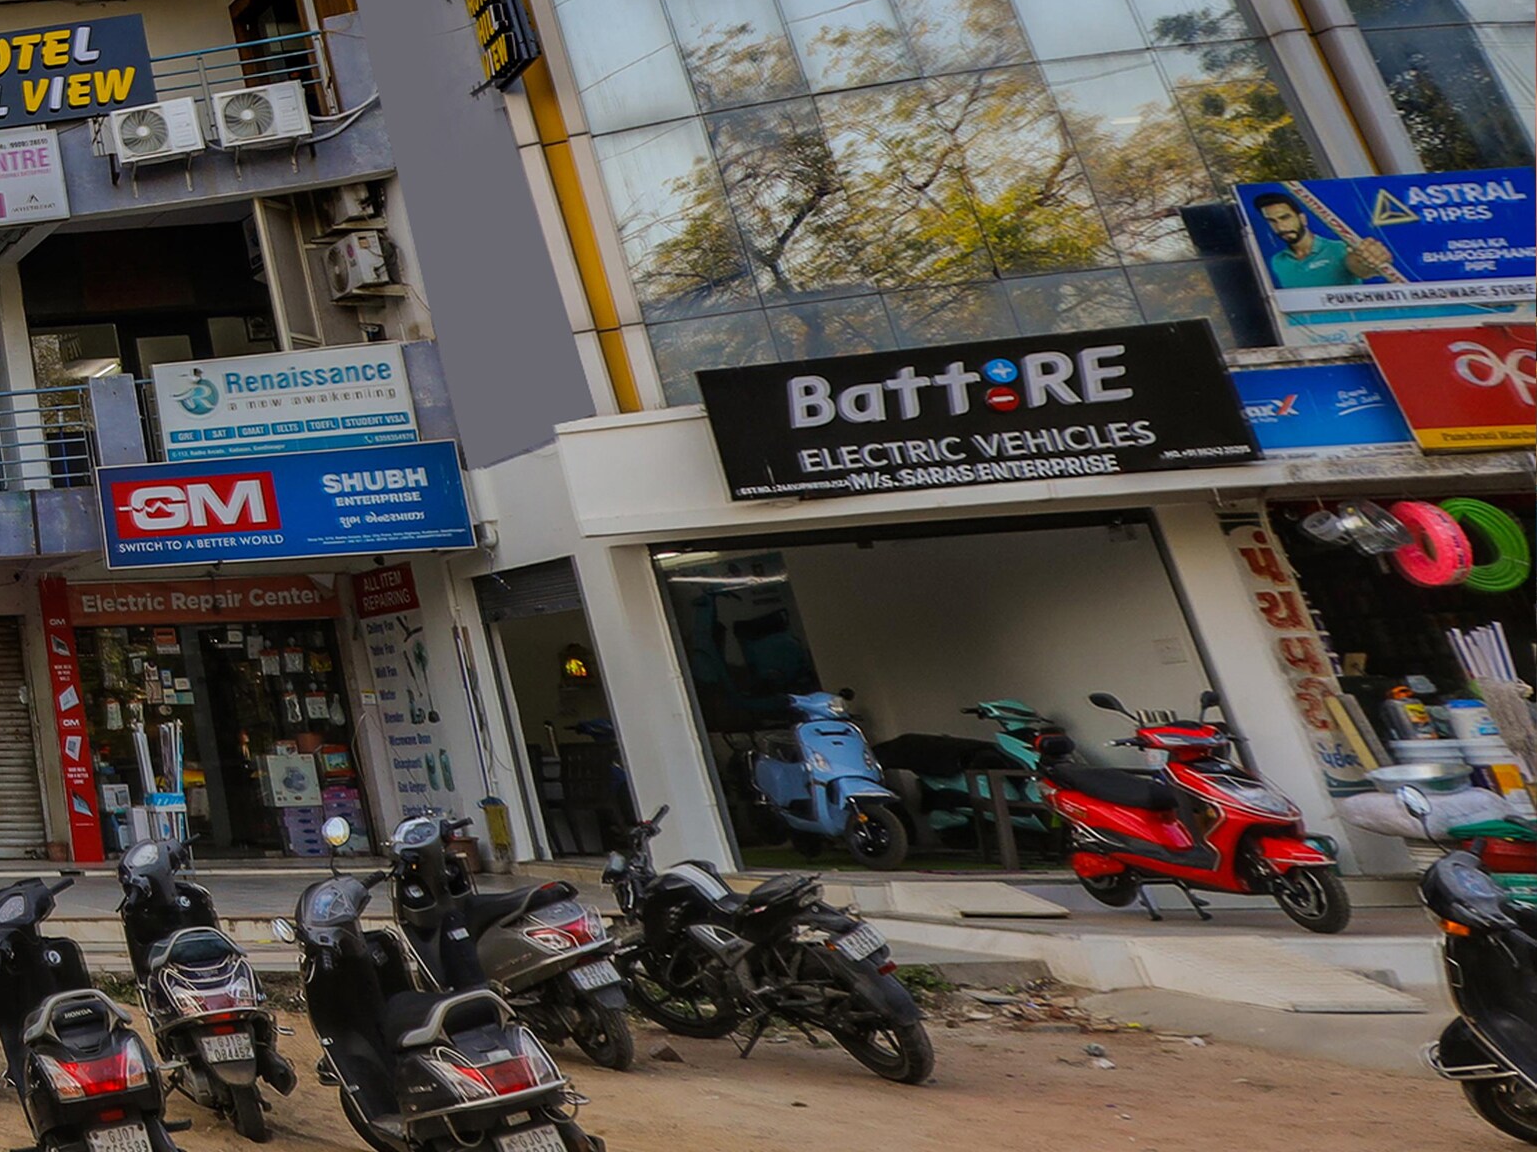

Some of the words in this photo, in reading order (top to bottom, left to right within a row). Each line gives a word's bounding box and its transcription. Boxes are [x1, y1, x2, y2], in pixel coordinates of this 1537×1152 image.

[22, 66, 136, 113] VIEW
[1408, 179, 1528, 205] ASTRAL
[1422, 205, 1493, 223] PIPES
[1326, 290, 1407, 305] PUNCHWATI
[1411, 285, 1488, 300] HARDWARE
[1490, 282, 1536, 296] STORE
[225, 360, 392, 394] Renaissance
[227, 401, 238, 412] a
[246, 397, 283, 411] new
[291, 386, 397, 408] awakening
[212, 428, 227, 439] SAT
[276, 422, 299, 433] IELTS
[310, 419, 336, 430] TOEFL
[344, 415, 385, 427] STUDENT
[386, 413, 406, 424] VISA
[798, 436, 963, 473] ELECTRIC
[971, 420, 1157, 458] VEHICLES
[322, 467, 429, 494] SHUBH
[901, 462, 975, 486] SARAS
[976, 452, 1120, 482] ENTERPRISE
[118, 480, 267, 531] GM
[335, 491, 422, 507] ENTERPRISE
[119, 540, 163, 553] SWITCH
[166, 541, 182, 551] TO
[186, 539, 195, 549] A
[197, 536, 237, 549] BETTER
[239, 532, 284, 546] WORLD
[363, 576, 380, 591] ALL
[381, 570, 402, 589] ITEM
[82, 590, 165, 613] Electric
[171, 587, 243, 614] Repair
[248, 581, 324, 607] Center
[363, 588, 411, 611] REPAIRING
[64, 1008, 93, 1020] HONDA
[108, 1126, 136, 1143] GJ07
